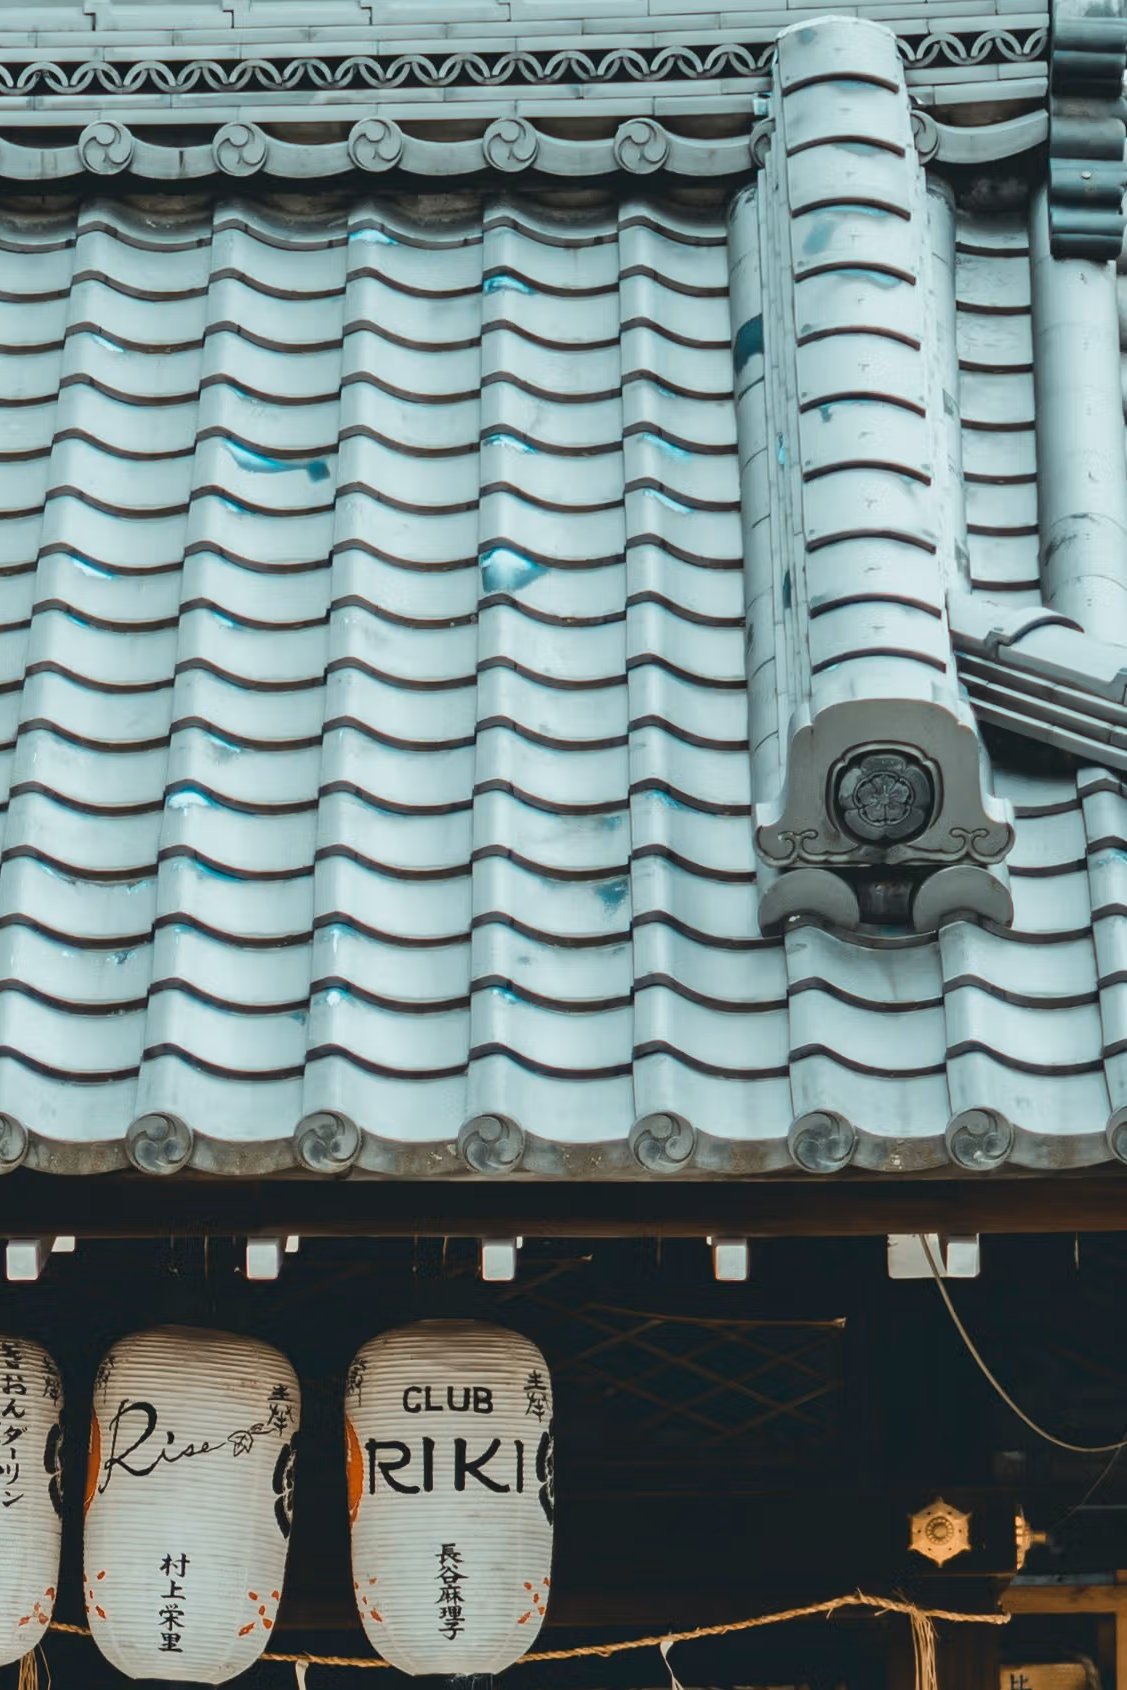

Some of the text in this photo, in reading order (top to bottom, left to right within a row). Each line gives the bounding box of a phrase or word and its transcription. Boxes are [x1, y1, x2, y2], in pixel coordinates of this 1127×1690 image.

[402, 1386, 494, 1414] CLUB
[365, 1436, 524, 1495] RIKI
[158, 1552, 190, 1653] 村上栄里
[435, 1543, 468, 1640] 長谷麻理子
